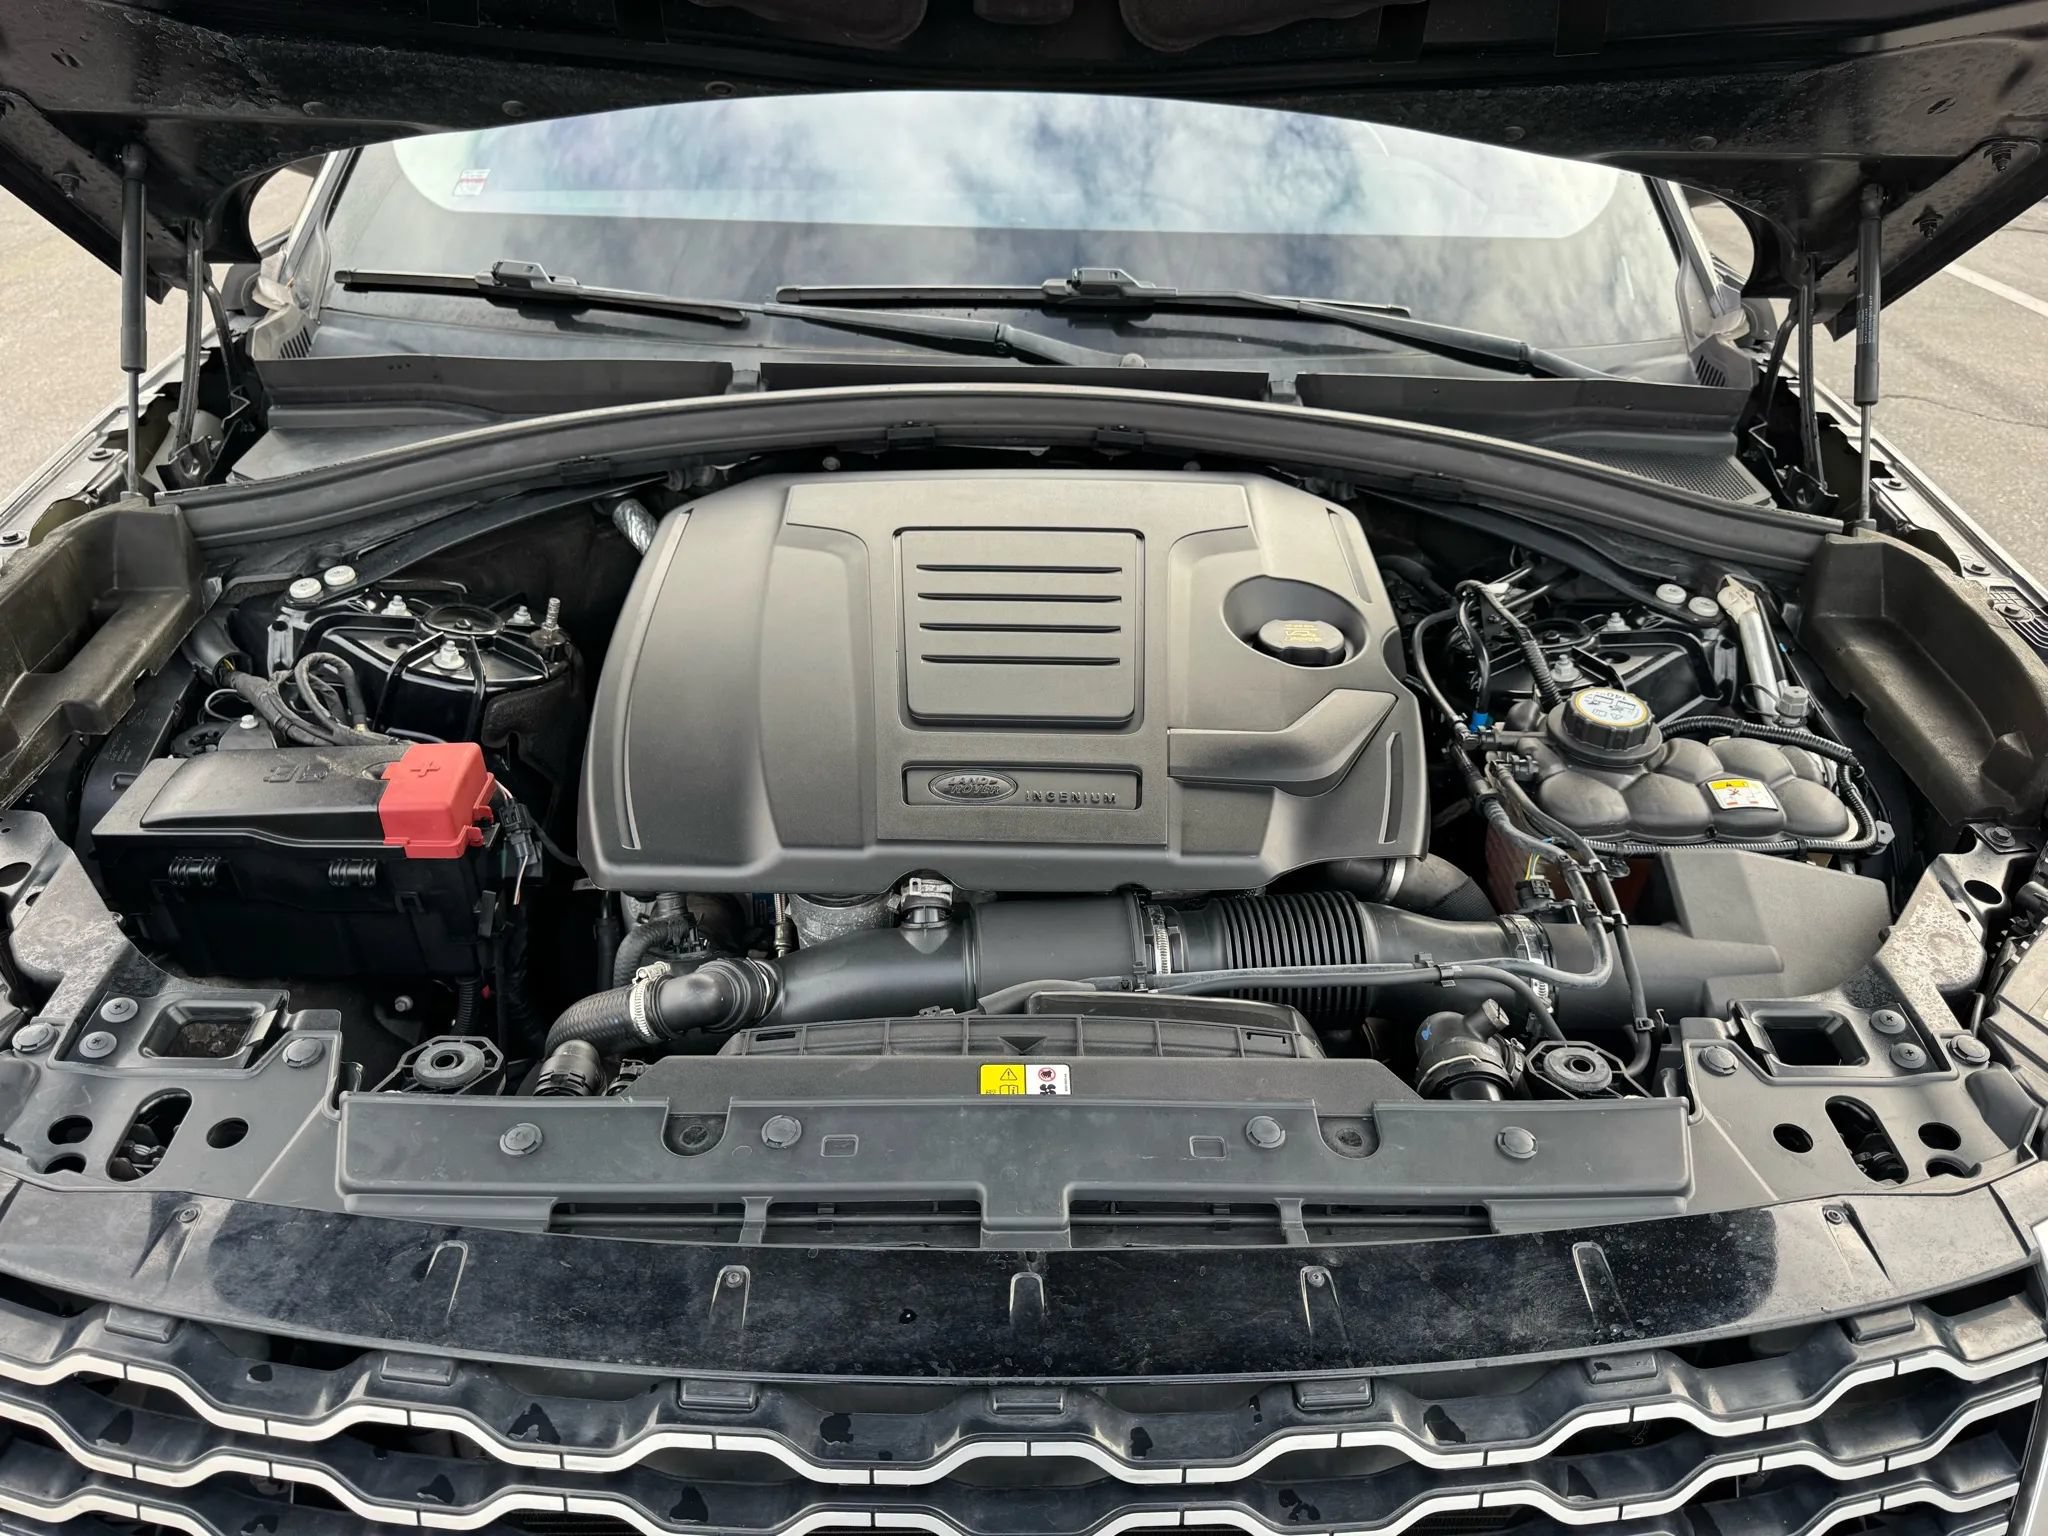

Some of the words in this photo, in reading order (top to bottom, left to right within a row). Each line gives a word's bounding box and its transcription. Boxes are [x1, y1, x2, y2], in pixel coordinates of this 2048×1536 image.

[948, 776, 989, 786] LAND
[951, 784, 1001, 794] ROVER
[1025, 790, 1117, 804] INGENIUM
